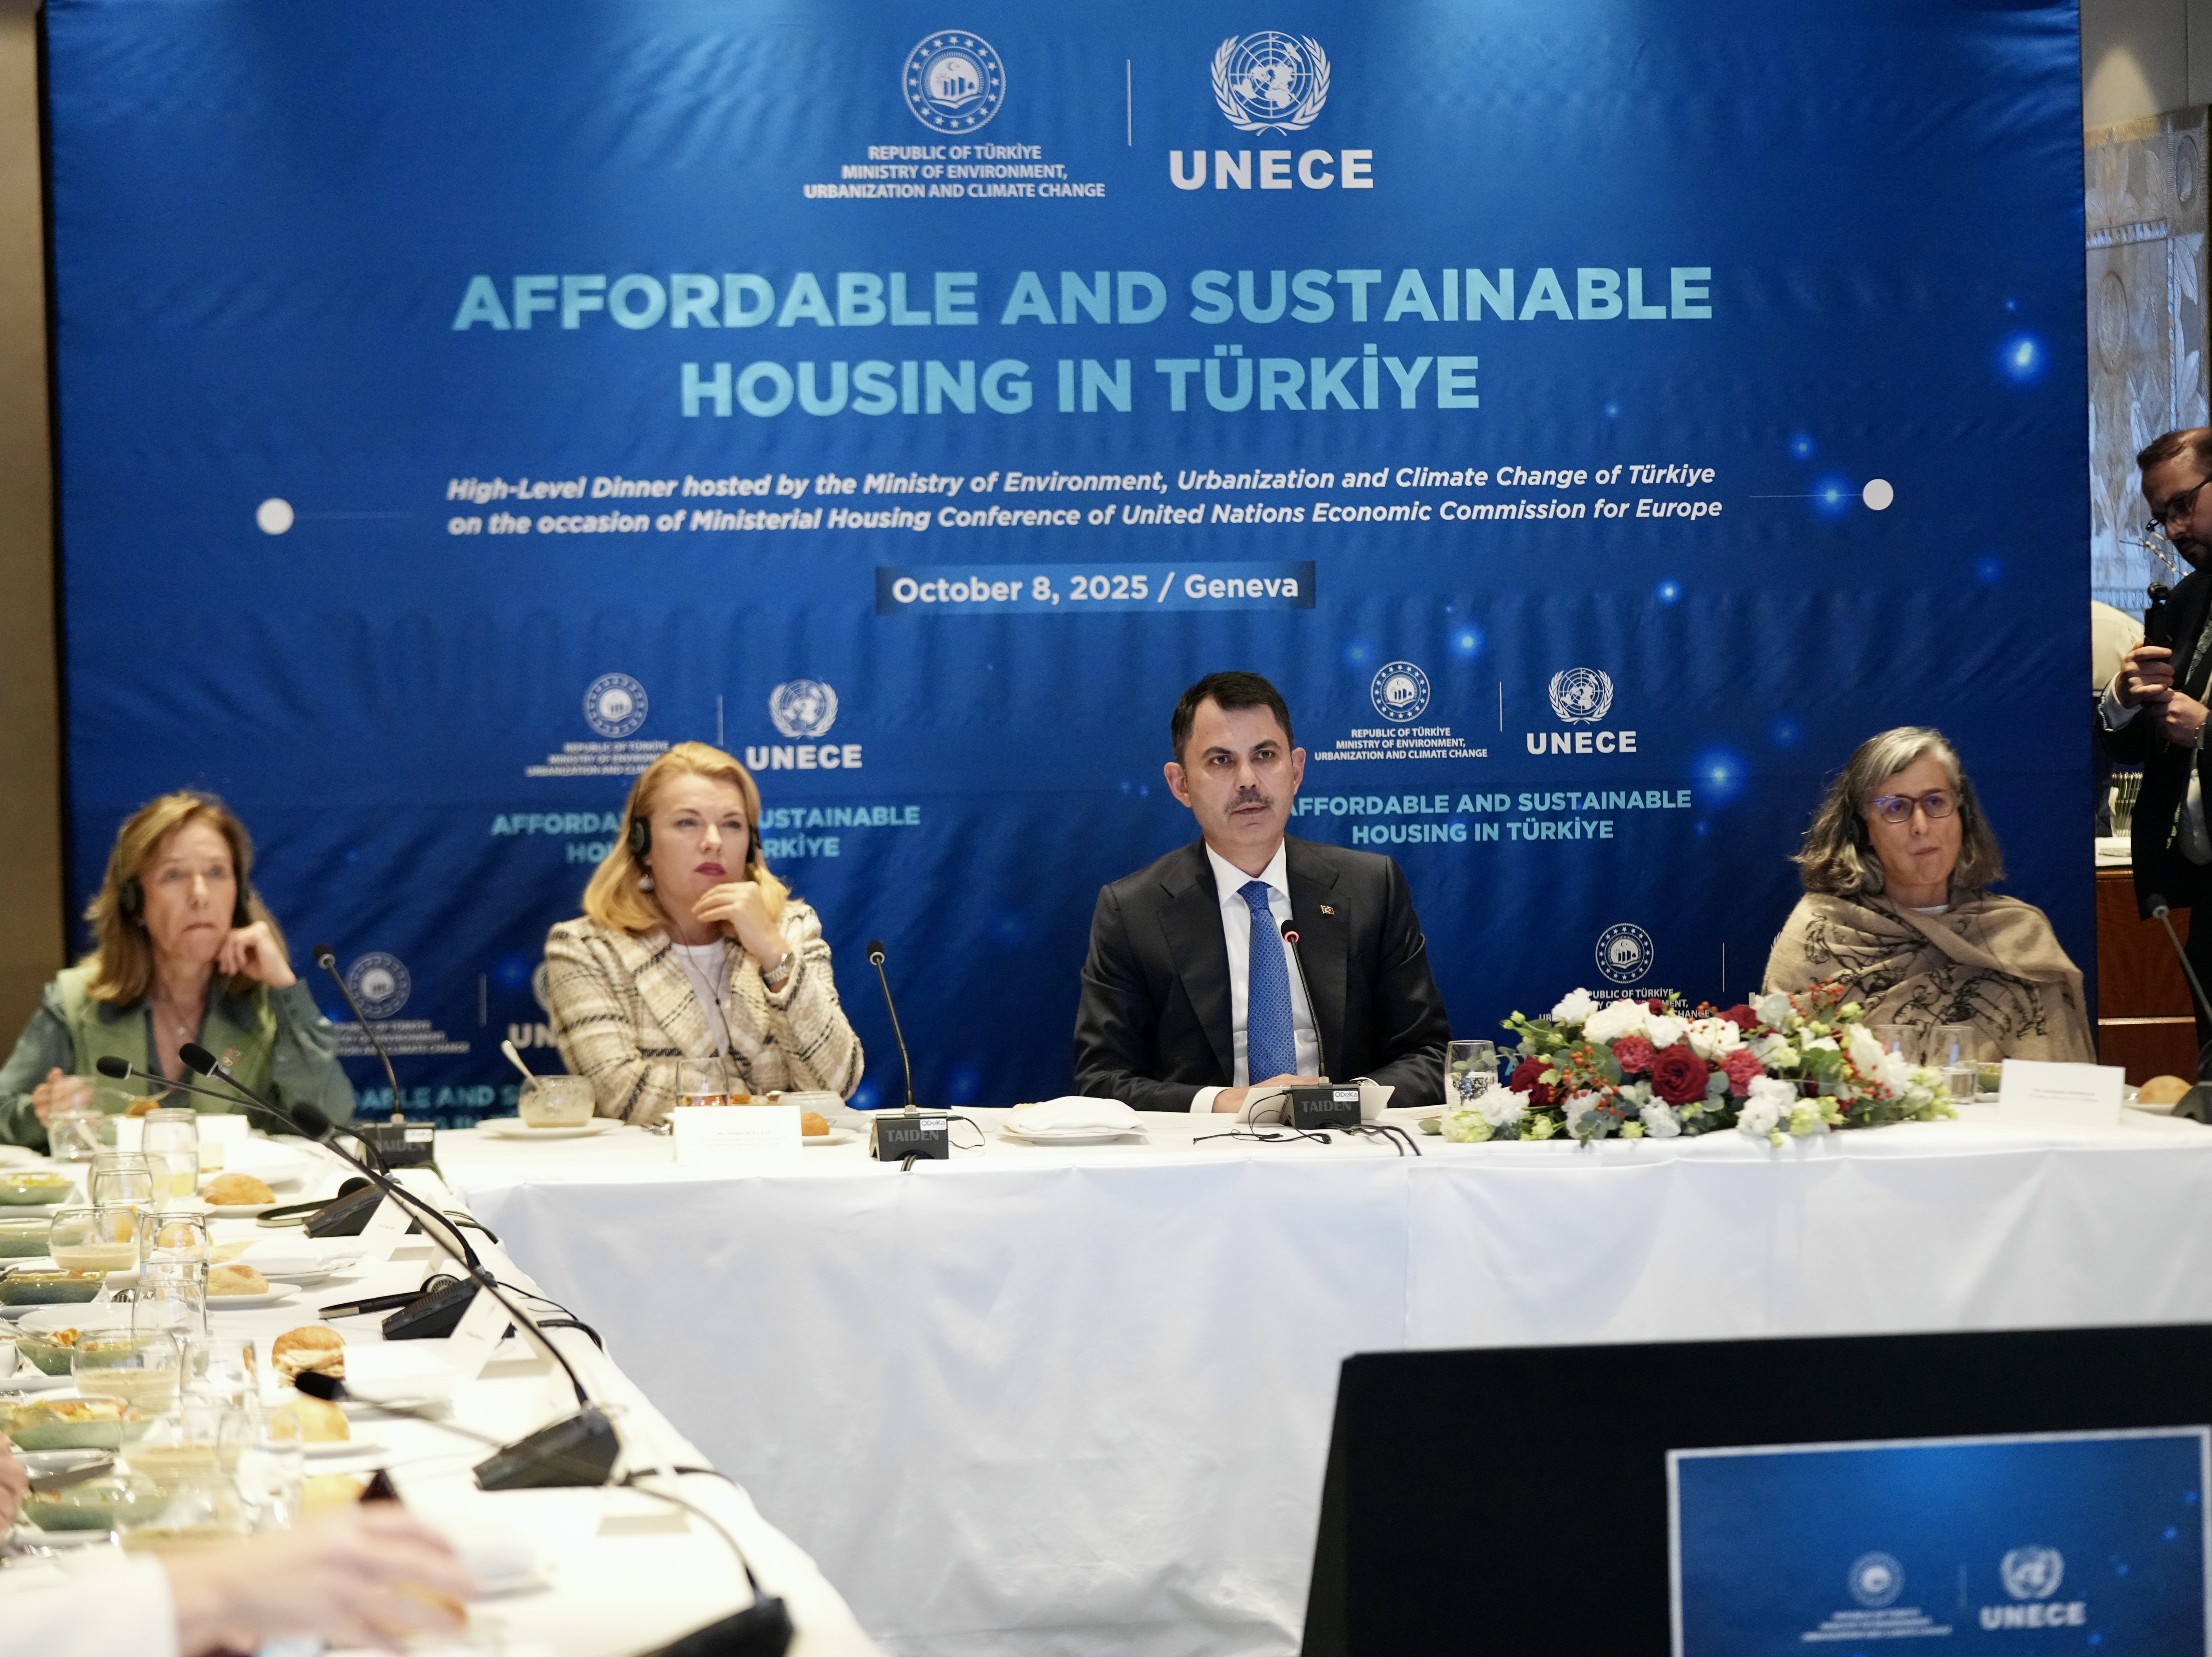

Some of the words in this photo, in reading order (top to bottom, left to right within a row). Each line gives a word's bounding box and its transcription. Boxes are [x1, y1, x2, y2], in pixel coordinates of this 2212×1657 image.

[868, 146, 946, 160] REPUBLIC
[949, 146, 971, 159] OF
[974, 143, 1041, 159] TÜRKİYE
[841, 165, 919, 179] MINISTRY
[921, 165, 943, 178] OF
[947, 165, 1067, 180] ENVIRONMENT,
[1170, 149, 1373, 190] UNECE
[804, 184, 925, 198] URBANIZATION
[928, 184, 965, 197] AND
[967, 184, 1035, 198] CLIMATE
[1038, 183, 1105, 197] CHANGE
[455, 272, 978, 330] AFFORDABLE
[1000, 271, 1167, 325] AND
[1190, 267, 1712, 323] SUSTAINABLE
[681, 359, 1032, 417] HOUSING
[1058, 359, 1131, 412] IN
[1155, 343, 1479, 411] TÜRKİYE
[447, 476, 587, 504] High-Level
[591, 476, 679, 498] Dinner
[682, 474, 772, 497] hosted
[776, 474, 810, 499] by
[815, 473, 857, 495] the
[863, 472, 964, 496] Ministry
[970, 472, 999, 492] of
[1004, 471, 1167, 494] Environment,
[1178, 468, 1334, 490] Urbanization
[1342, 468, 1389, 488] and
[1396, 467, 1488, 487] Climate
[1497, 466, 1587, 488] Change
[1595, 465, 1622, 484] of
[1630, 464, 1715, 487] Türkiye
[448, 517, 482, 535] on
[488, 512, 531, 534] the
[537, 511, 650, 533] occasion
[655, 509, 687, 531] of
[690, 508, 823, 531] Ministerial
[827, 507, 931, 531] Housing
[938, 505, 1081, 527] Conference
[1088, 504, 1116, 525] of
[1122, 503, 1205, 525] United
[1211, 503, 1305, 523] Nations
[1312, 501, 1432, 522] Economic
[1440, 499, 1585, 520] Commission
[1594, 499, 1630, 518] for
[1636, 499, 1722, 520] Europe
[893, 576, 1023, 603] October
[1032, 576, 1059, 605] 8,
[1069, 575, 1149, 600] 2025
[1158, 572, 1175, 603] /
[1184, 574, 1298, 598] Geneva
[1336, 740, 1380, 749] MINISTRY
[1382, 740, 1394, 748] OF
[1396, 738, 1465, 748] ENVIRONMENT,
[1351, 729, 1396, 738] REPUBLIC
[1398, 728, 1410, 737] OF
[1412, 726, 1451, 736] TÜRKİYE
[1527, 731, 1636, 754] UNECE
[746, 744, 862, 770] UNECE
[1315, 751, 1384, 760] URBANIZATION
[1386, 750, 1406, 759] AND
[1408, 750, 1447, 758] CLIMATE
[1449, 749, 1487, 758] CHANGE
[1457, 794, 1510, 813] AND
[1518, 790, 1691, 811] SUSTAINABLE
[491, 812, 622, 835] AFFORDA
[757, 805, 920, 829] USTAINABLE
[1353, 823, 1467, 844] HOUSING
[1475, 823, 1498, 841] IN
[1506, 817, 1613, 840] TÜRKİYE
[762, 833, 840, 858] RKİYE
[1621, 989, 1634, 998] OF
[1635, 987, 1674, 998] TÜRKİYE
[1301, 1100, 1351, 1113] TAIDEN
[886, 1130, 939, 1142] TAIDEN
[1980, 1602, 2086, 1630] UNECE
